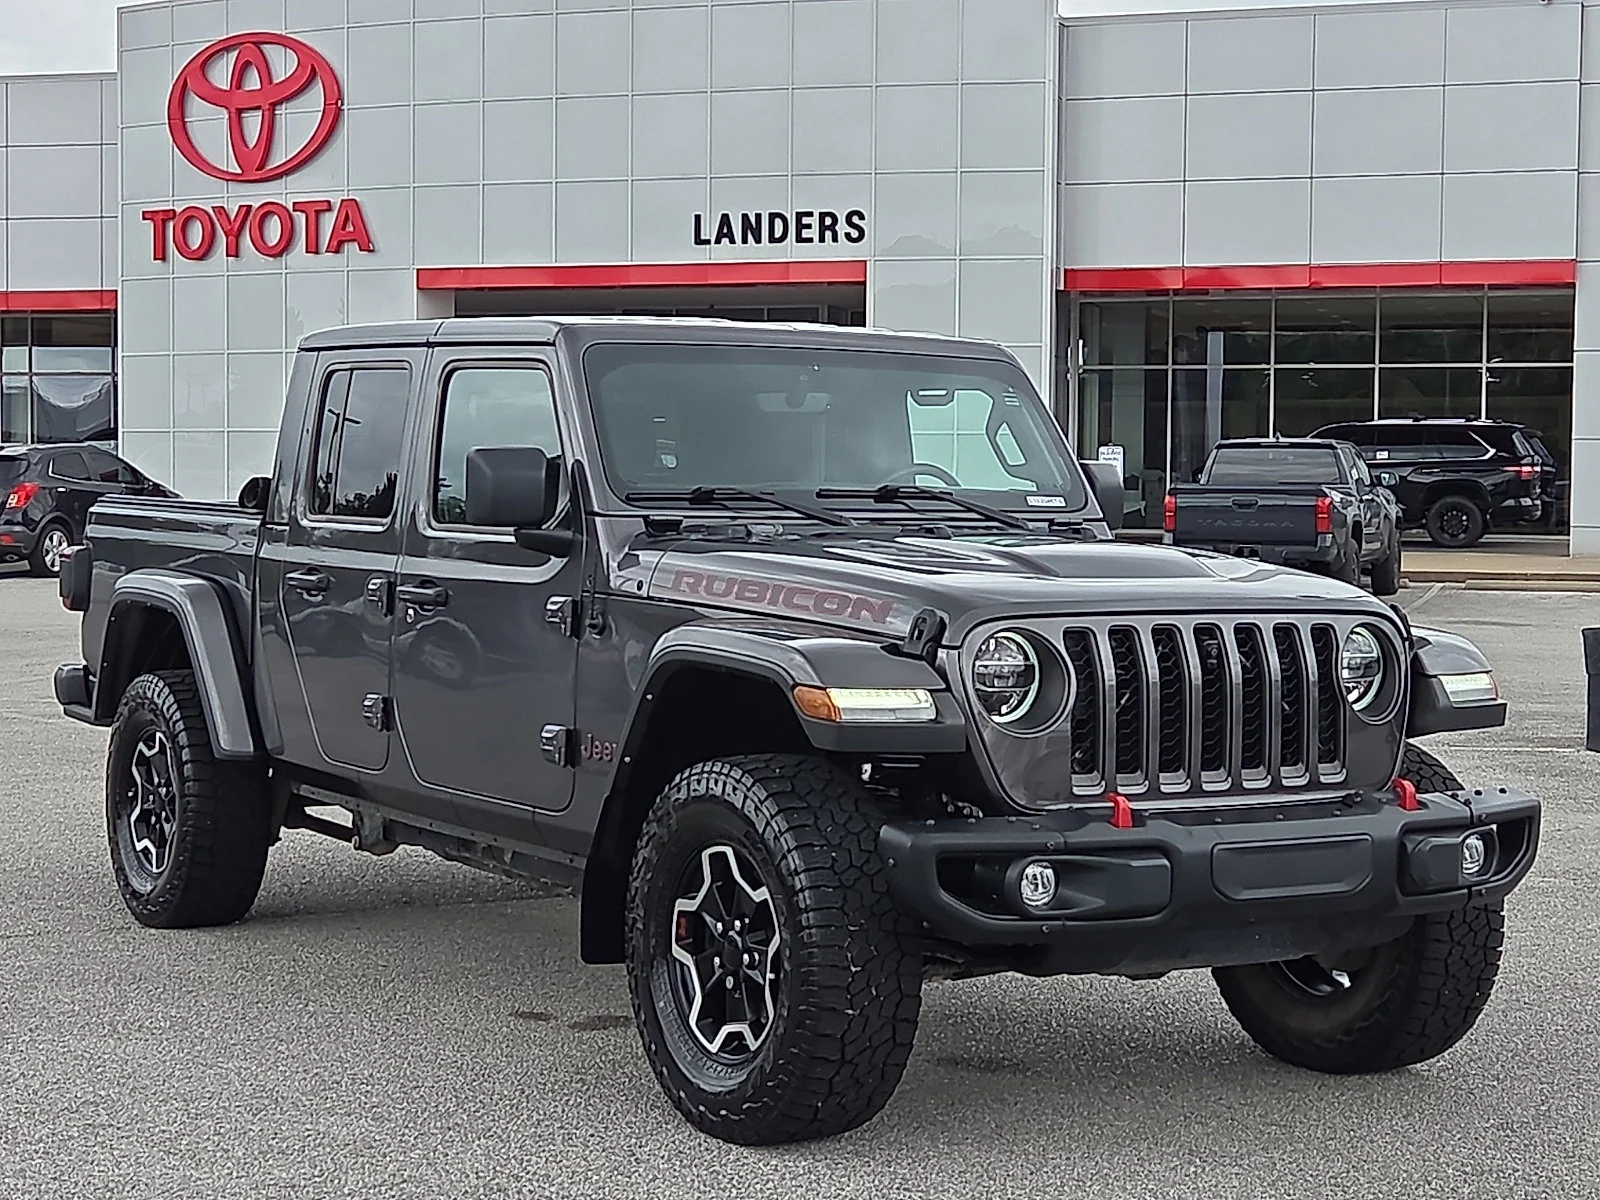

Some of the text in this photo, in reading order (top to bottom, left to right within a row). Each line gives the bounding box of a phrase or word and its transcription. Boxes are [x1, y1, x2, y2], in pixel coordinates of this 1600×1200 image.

[142, 198, 374, 261] TOYOTA
[693, 209, 866, 245] LANDERS
[1197, 518, 1295, 528] TACOMA
[671, 569, 896, 623] RUBICON
